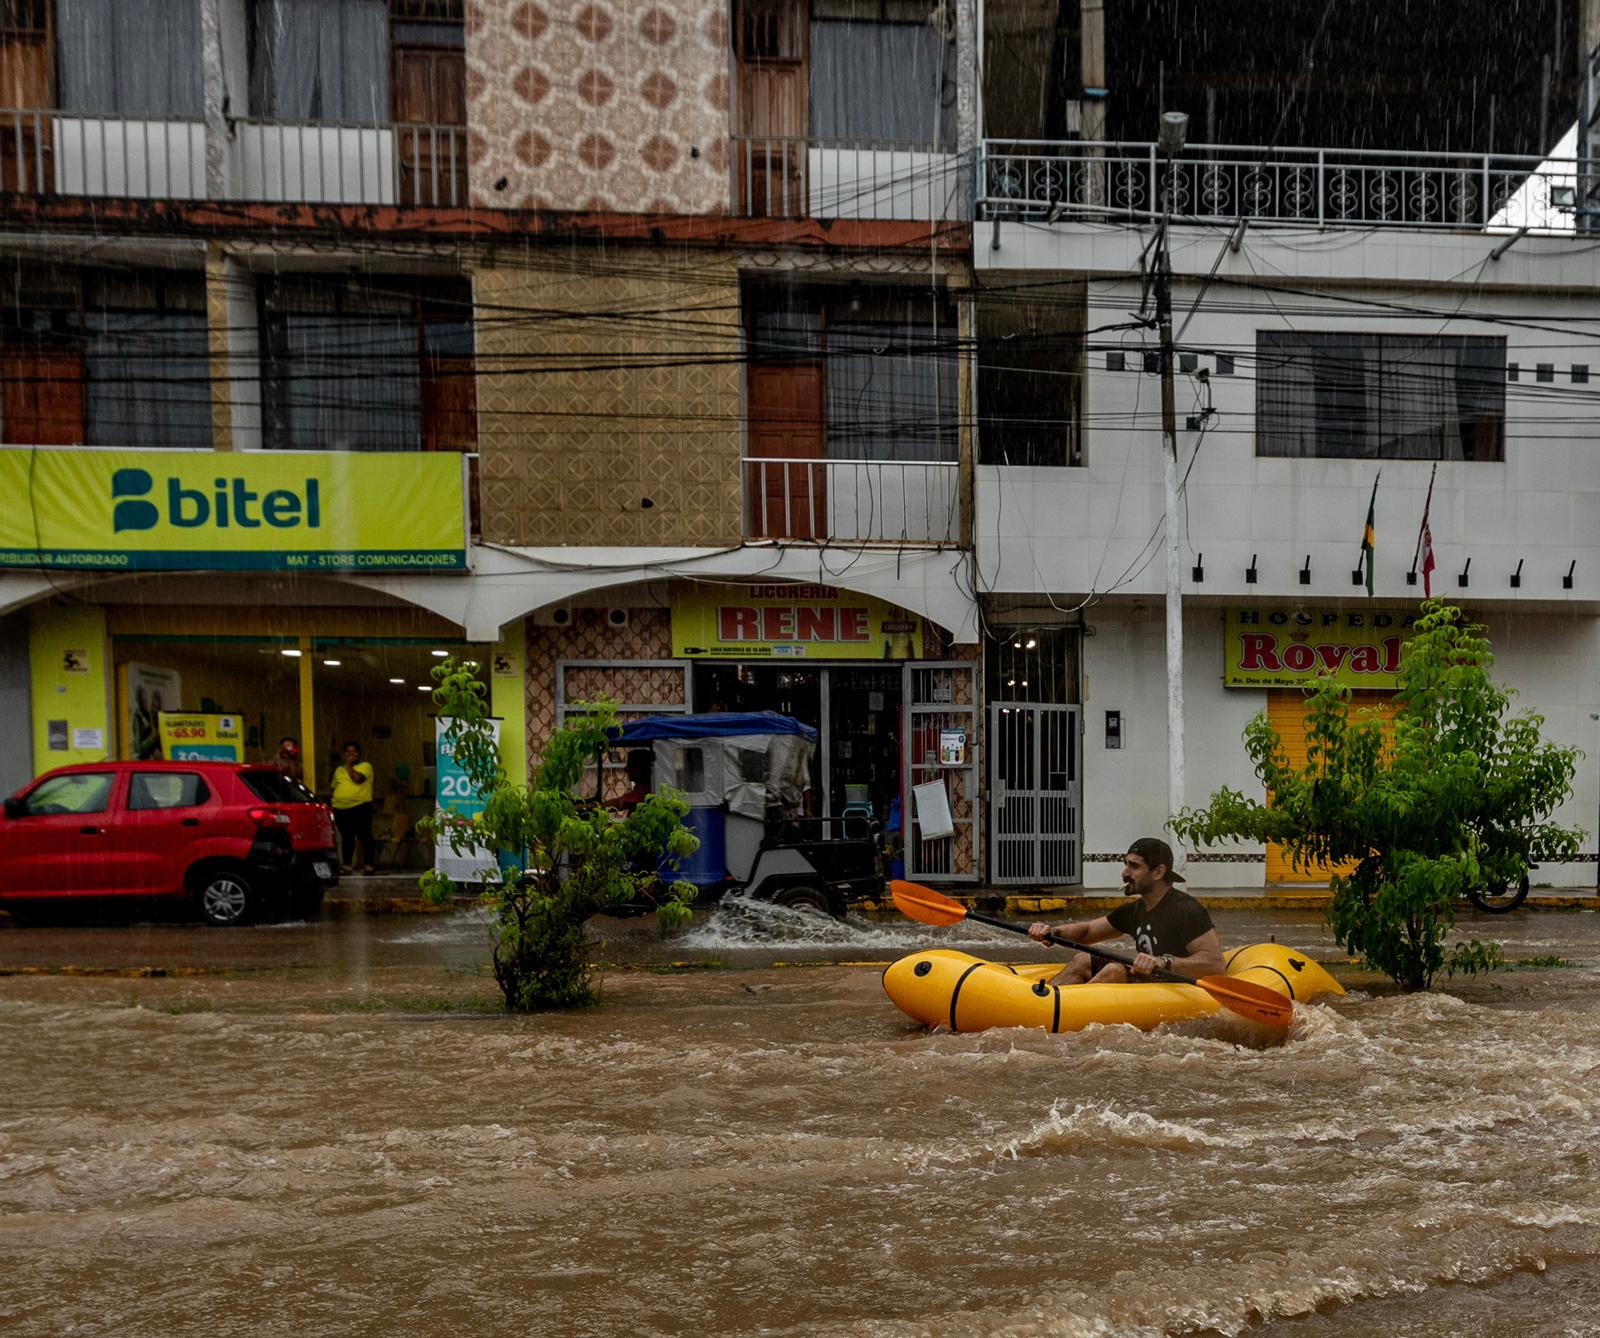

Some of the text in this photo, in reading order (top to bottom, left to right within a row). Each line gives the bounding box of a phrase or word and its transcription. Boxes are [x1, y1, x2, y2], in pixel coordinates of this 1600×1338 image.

[167, 477, 320, 528] bitel
[55, 553, 129, 565] AUTORIZADO
[286, 555, 309, 566] MAT
[318, 555, 355, 566] STORE
[357, 554, 458, 566] COMUNICACIONES
[719, 606, 871, 641] RENE
[1239, 611, 1470, 628] HOSPEDA
[1238, 632, 1404, 679] Royal
[1274, 678, 1294, 686] Mayo
